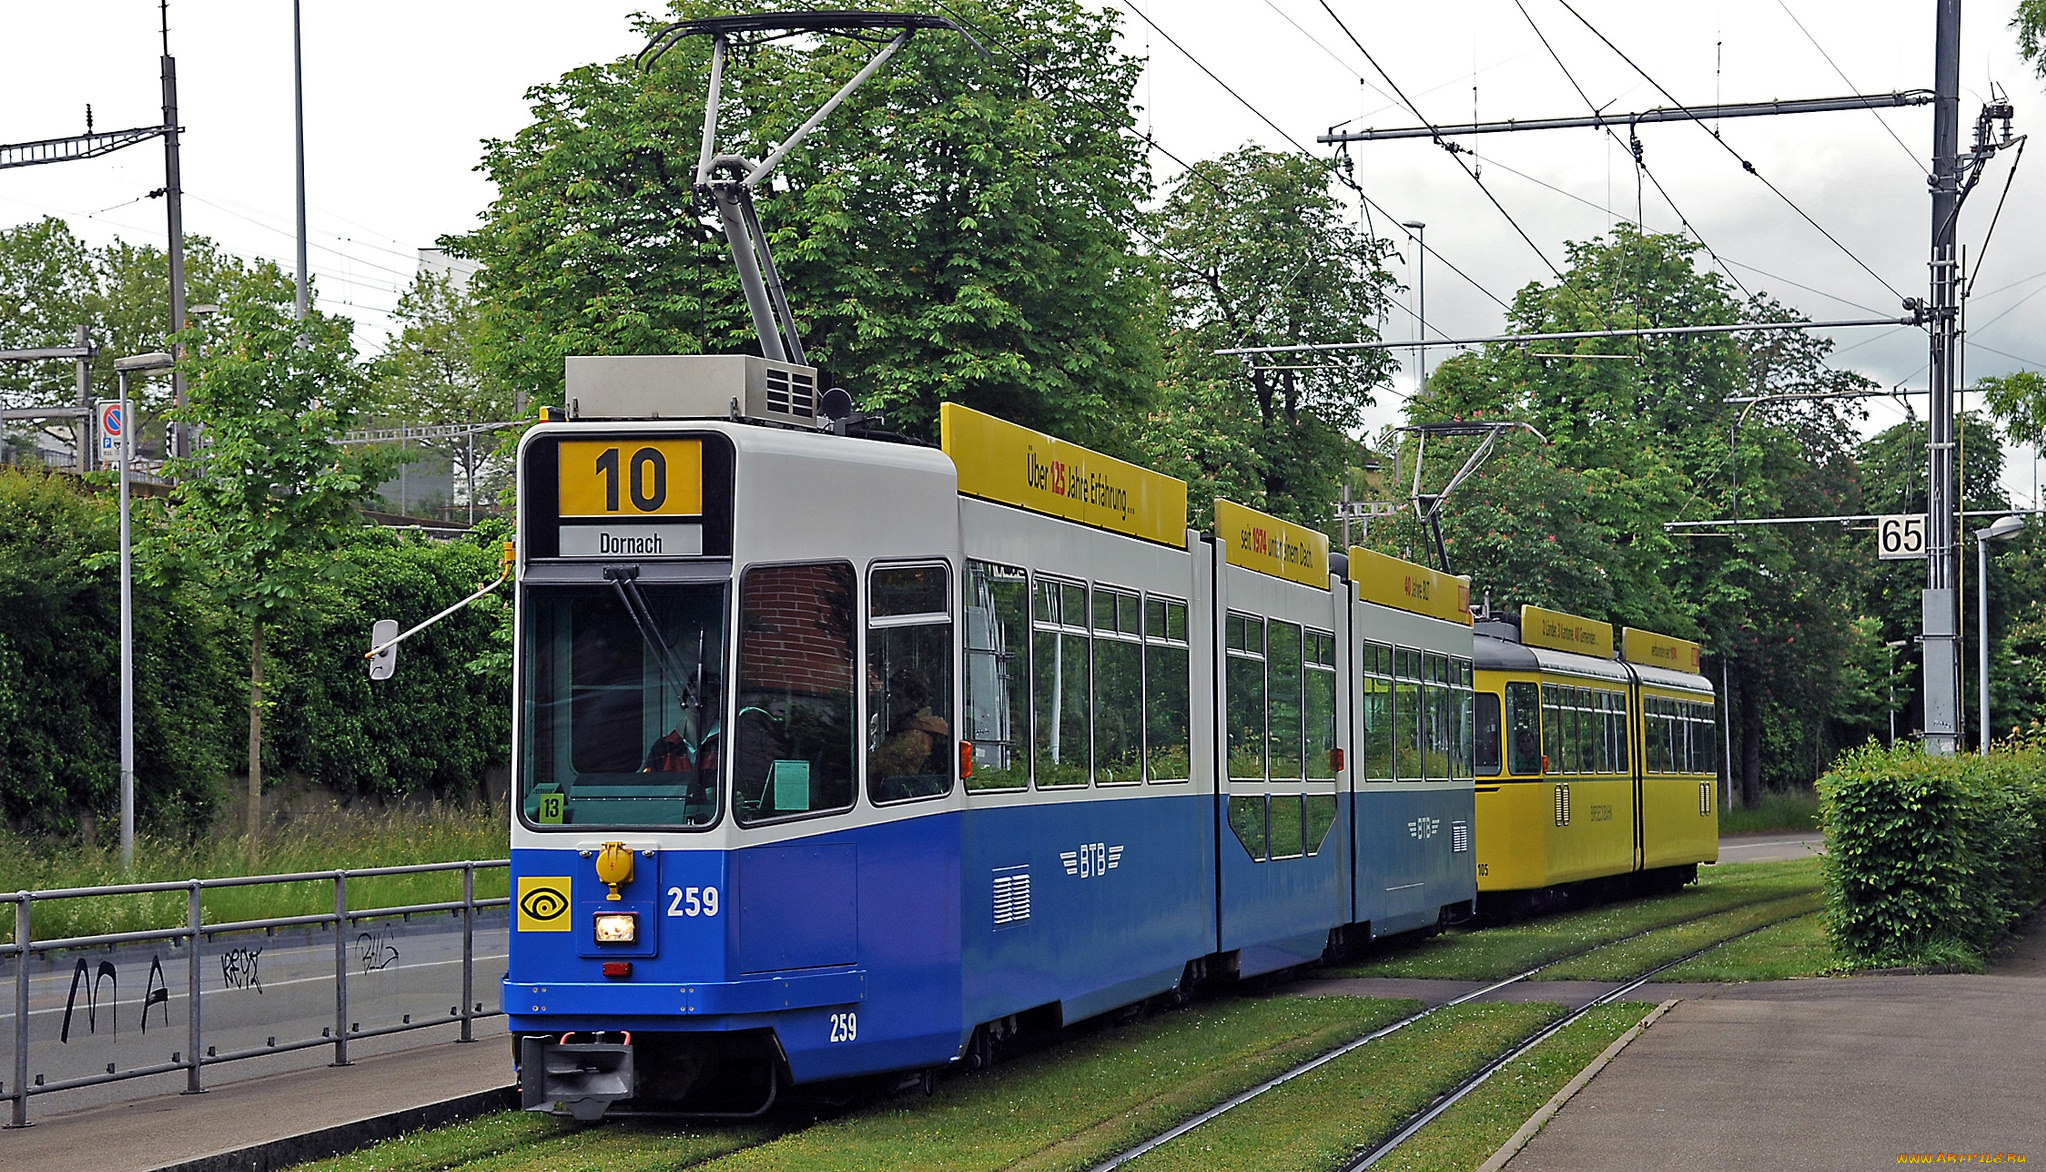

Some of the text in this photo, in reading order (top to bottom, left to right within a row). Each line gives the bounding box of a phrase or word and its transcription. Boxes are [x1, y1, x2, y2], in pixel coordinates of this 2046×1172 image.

[596, 447, 666, 512] 10
[1027, 445, 1048, 490] Über
[1050, 461, 1066, 496] 125
[1067, 466, 1088, 503] Jahre
[600, 533, 662, 554] Dornach
[1241, 524, 1251, 550] seit
[1253, 528, 1266, 555] 1974
[1883, 520, 1922, 552] 65
[1405, 576, 1411, 596] 40
[544, 798, 559, 817] 13
[1418, 817, 1431, 839] BTB
[1080, 842, 1106, 878] BTB
[1477, 864, 1488, 876] 105
[667, 886, 719, 917] 259
[830, 1013, 857, 1042] 259
